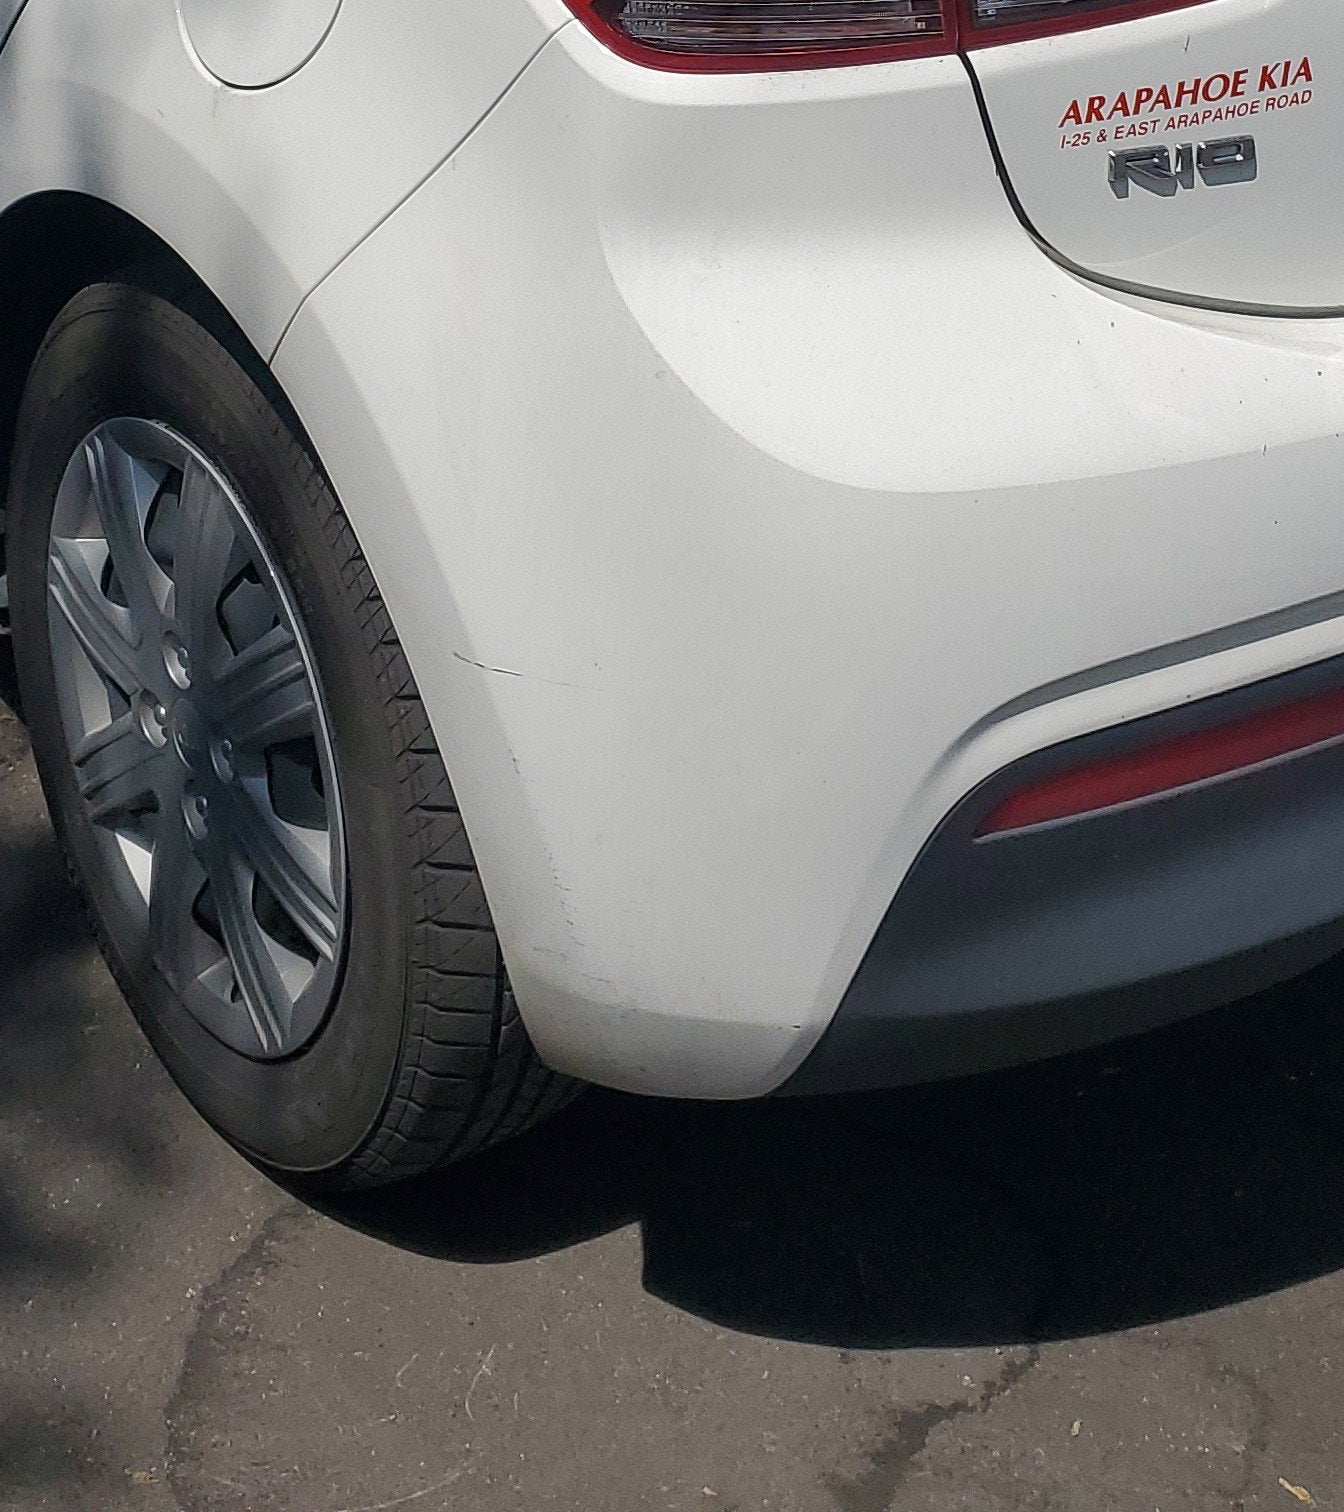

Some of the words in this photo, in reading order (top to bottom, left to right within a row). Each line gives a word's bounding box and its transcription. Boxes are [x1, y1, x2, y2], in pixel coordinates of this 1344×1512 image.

[1058, 68, 1249, 128] ARAPAHOE
[1258, 56, 1313, 92] KIA
[1060, 131, 1091, 149] I-25
[1096, 129, 1108, 144] &
[1114, 119, 1161, 140] EAST
[1164, 100, 1259, 131] ARAPAHOE
[1265, 89, 1312, 111] ROAD
[1108, 134, 1257, 199] RIO
